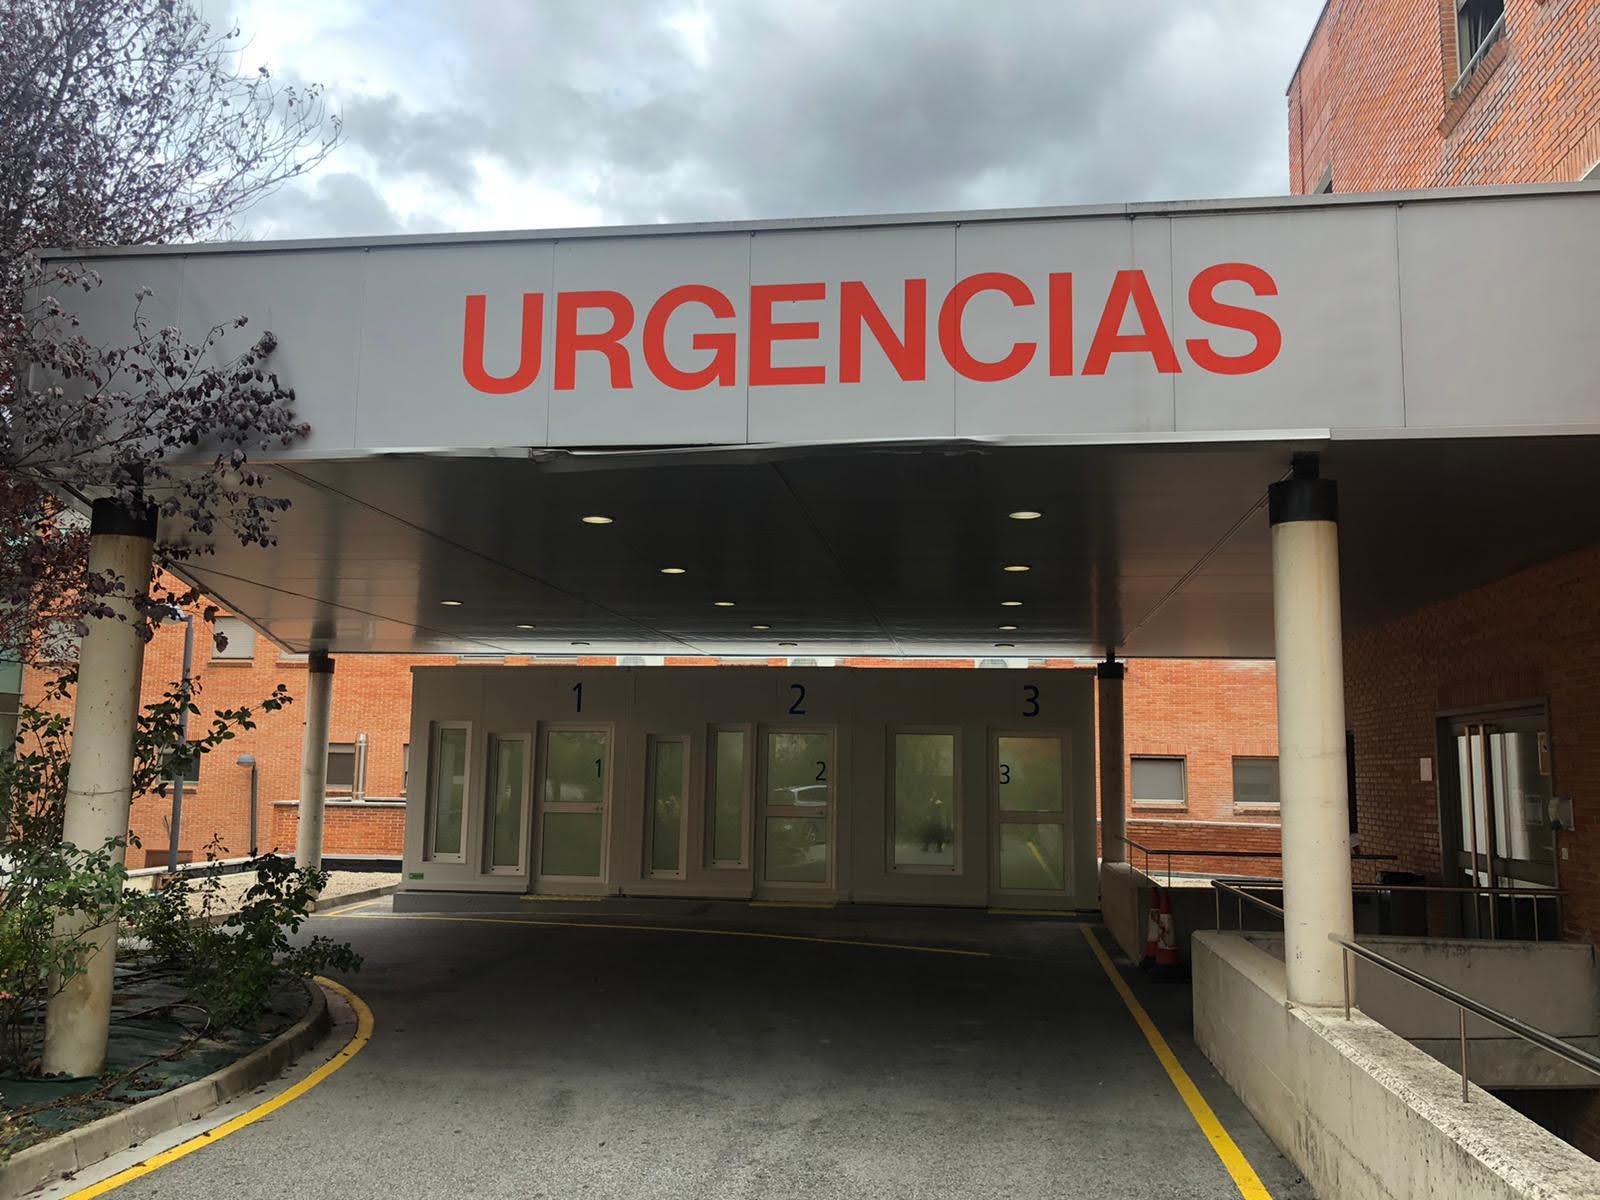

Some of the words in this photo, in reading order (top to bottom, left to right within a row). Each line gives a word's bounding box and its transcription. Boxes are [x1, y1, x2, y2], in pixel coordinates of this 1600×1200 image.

[462, 262, 1282, 394] URGENCIAS
[572, 682, 584, 713] 1
[788, 684, 807, 715] 2
[1022, 685, 1040, 717] 3
[595, 758, 603, 778] 1
[815, 761, 827, 781] 2
[999, 764, 1011, 785] 3
